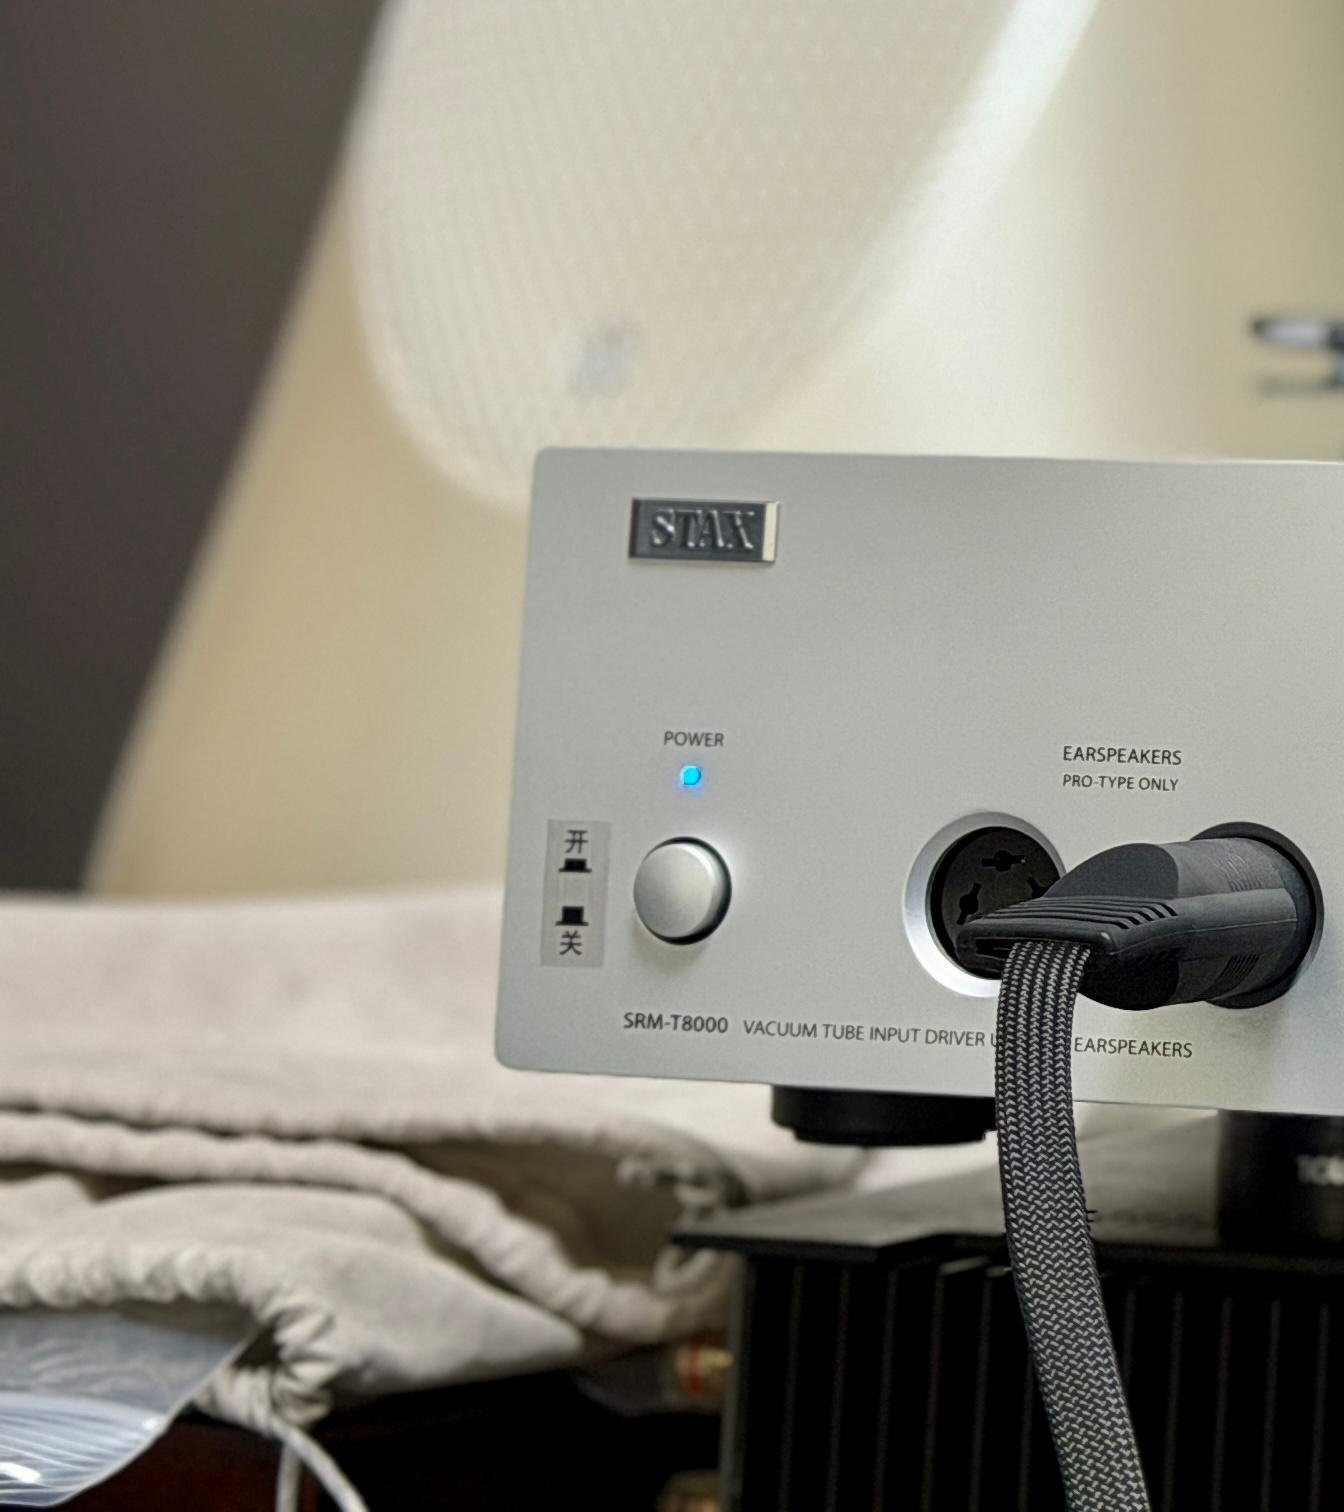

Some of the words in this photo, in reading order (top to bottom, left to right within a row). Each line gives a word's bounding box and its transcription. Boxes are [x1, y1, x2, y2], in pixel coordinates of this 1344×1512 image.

[650, 507, 756, 550] STAX
[663, 730, 726, 749] POWER
[1062, 745, 1183, 767] EARSPEAKERS
[1062, 773, 1135, 791] PRO-TYPE
[1138, 775, 1180, 792] ONLY
[564, 829, 589, 854] 开
[559, 930, 582, 956] 关
[623, 1011, 729, 1034] SRM-T8000
[743, 1019, 818, 1039] VACUUM
[822, 1023, 865, 1041] TUBE
[869, 1026, 921, 1044] INPUT
[924, 1028, 986, 1048] DRIVER
[1074, 1036, 1193, 1059] EARSPEAKERS
